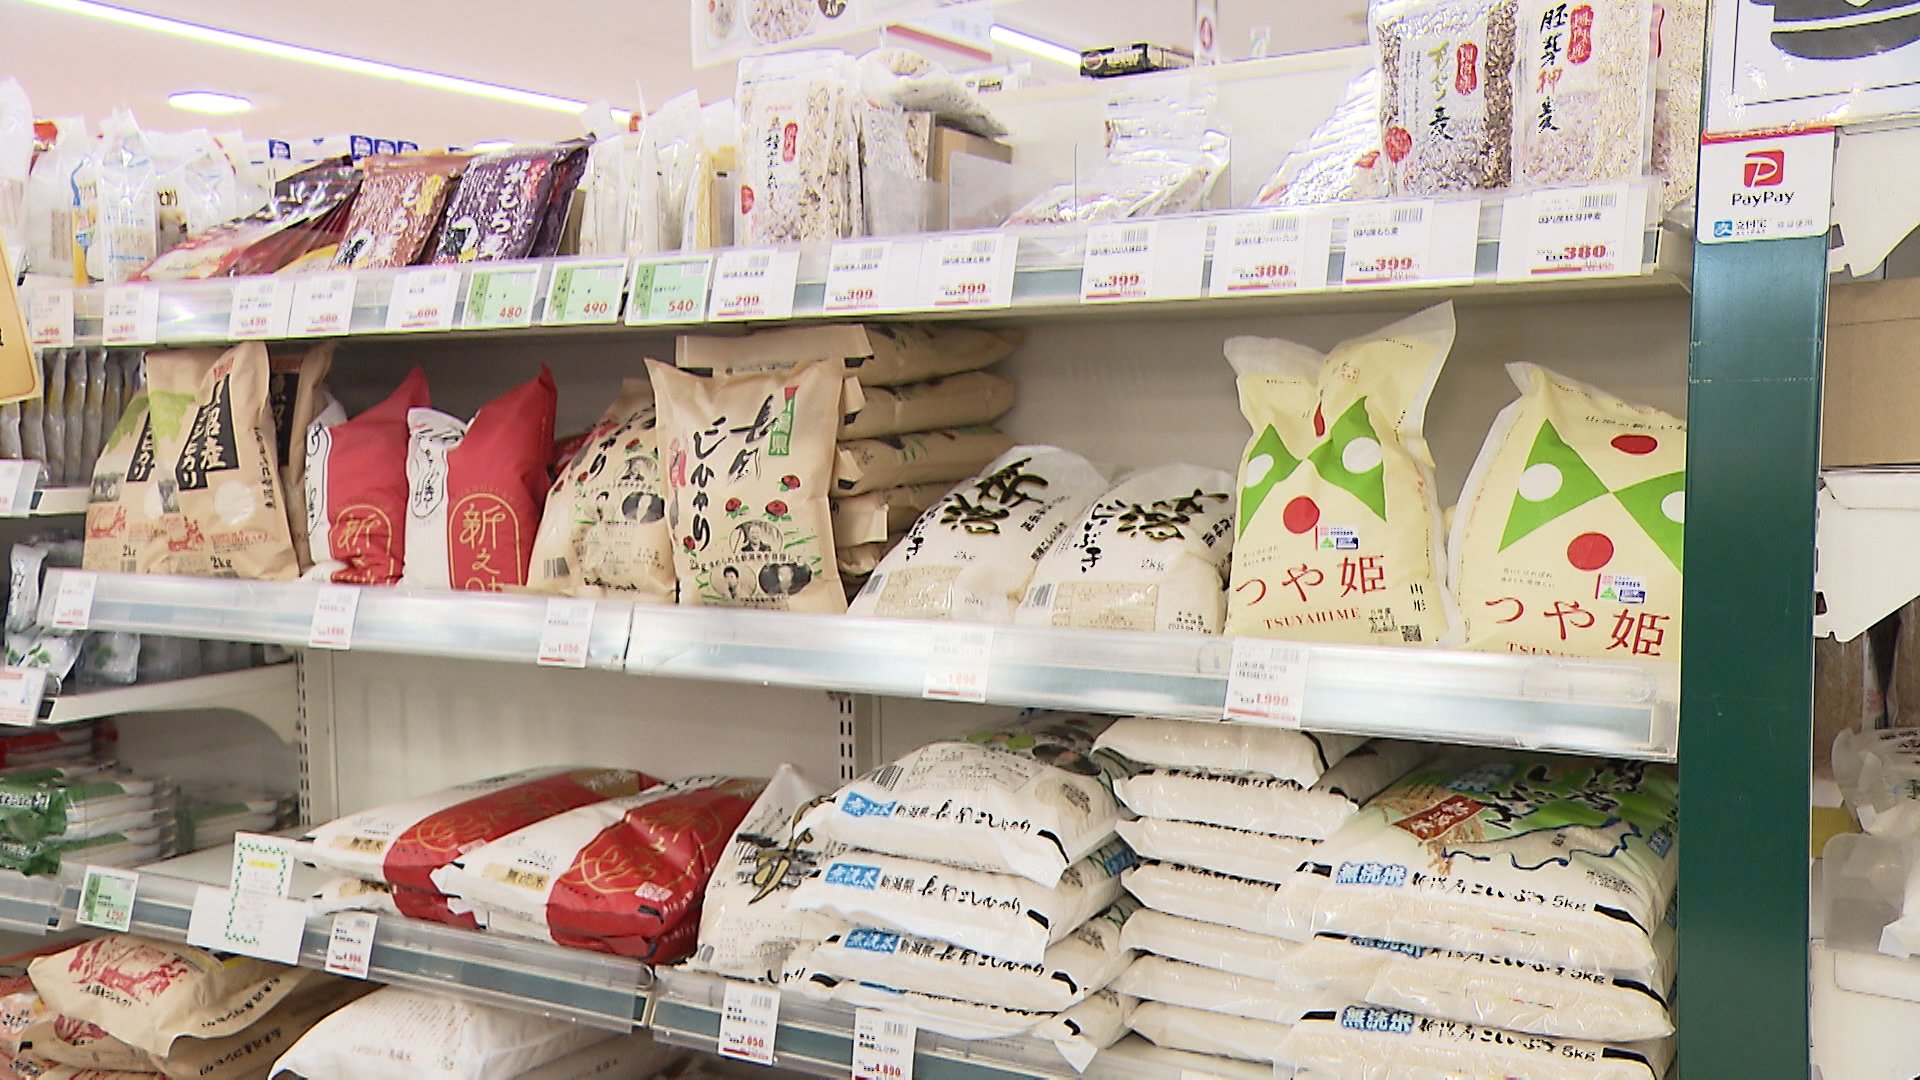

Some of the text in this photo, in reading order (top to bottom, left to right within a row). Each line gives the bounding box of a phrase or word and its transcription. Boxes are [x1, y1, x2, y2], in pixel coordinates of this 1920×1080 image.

[1731, 190, 1795, 208] PayPay
[1563, 243, 1607, 259] 380
[1375, 256, 1413, 272] 399
[498, 306, 523, 318] 480
[583, 303, 608, 314] 490
[668, 300, 694, 312] 540
[689, 414, 728, 552] こしひかり
[1235, 554, 1387, 608] つや姫
[1262, 606, 1362, 631] TSUYAHIME
[1485, 595, 1671, 657] つや姫
